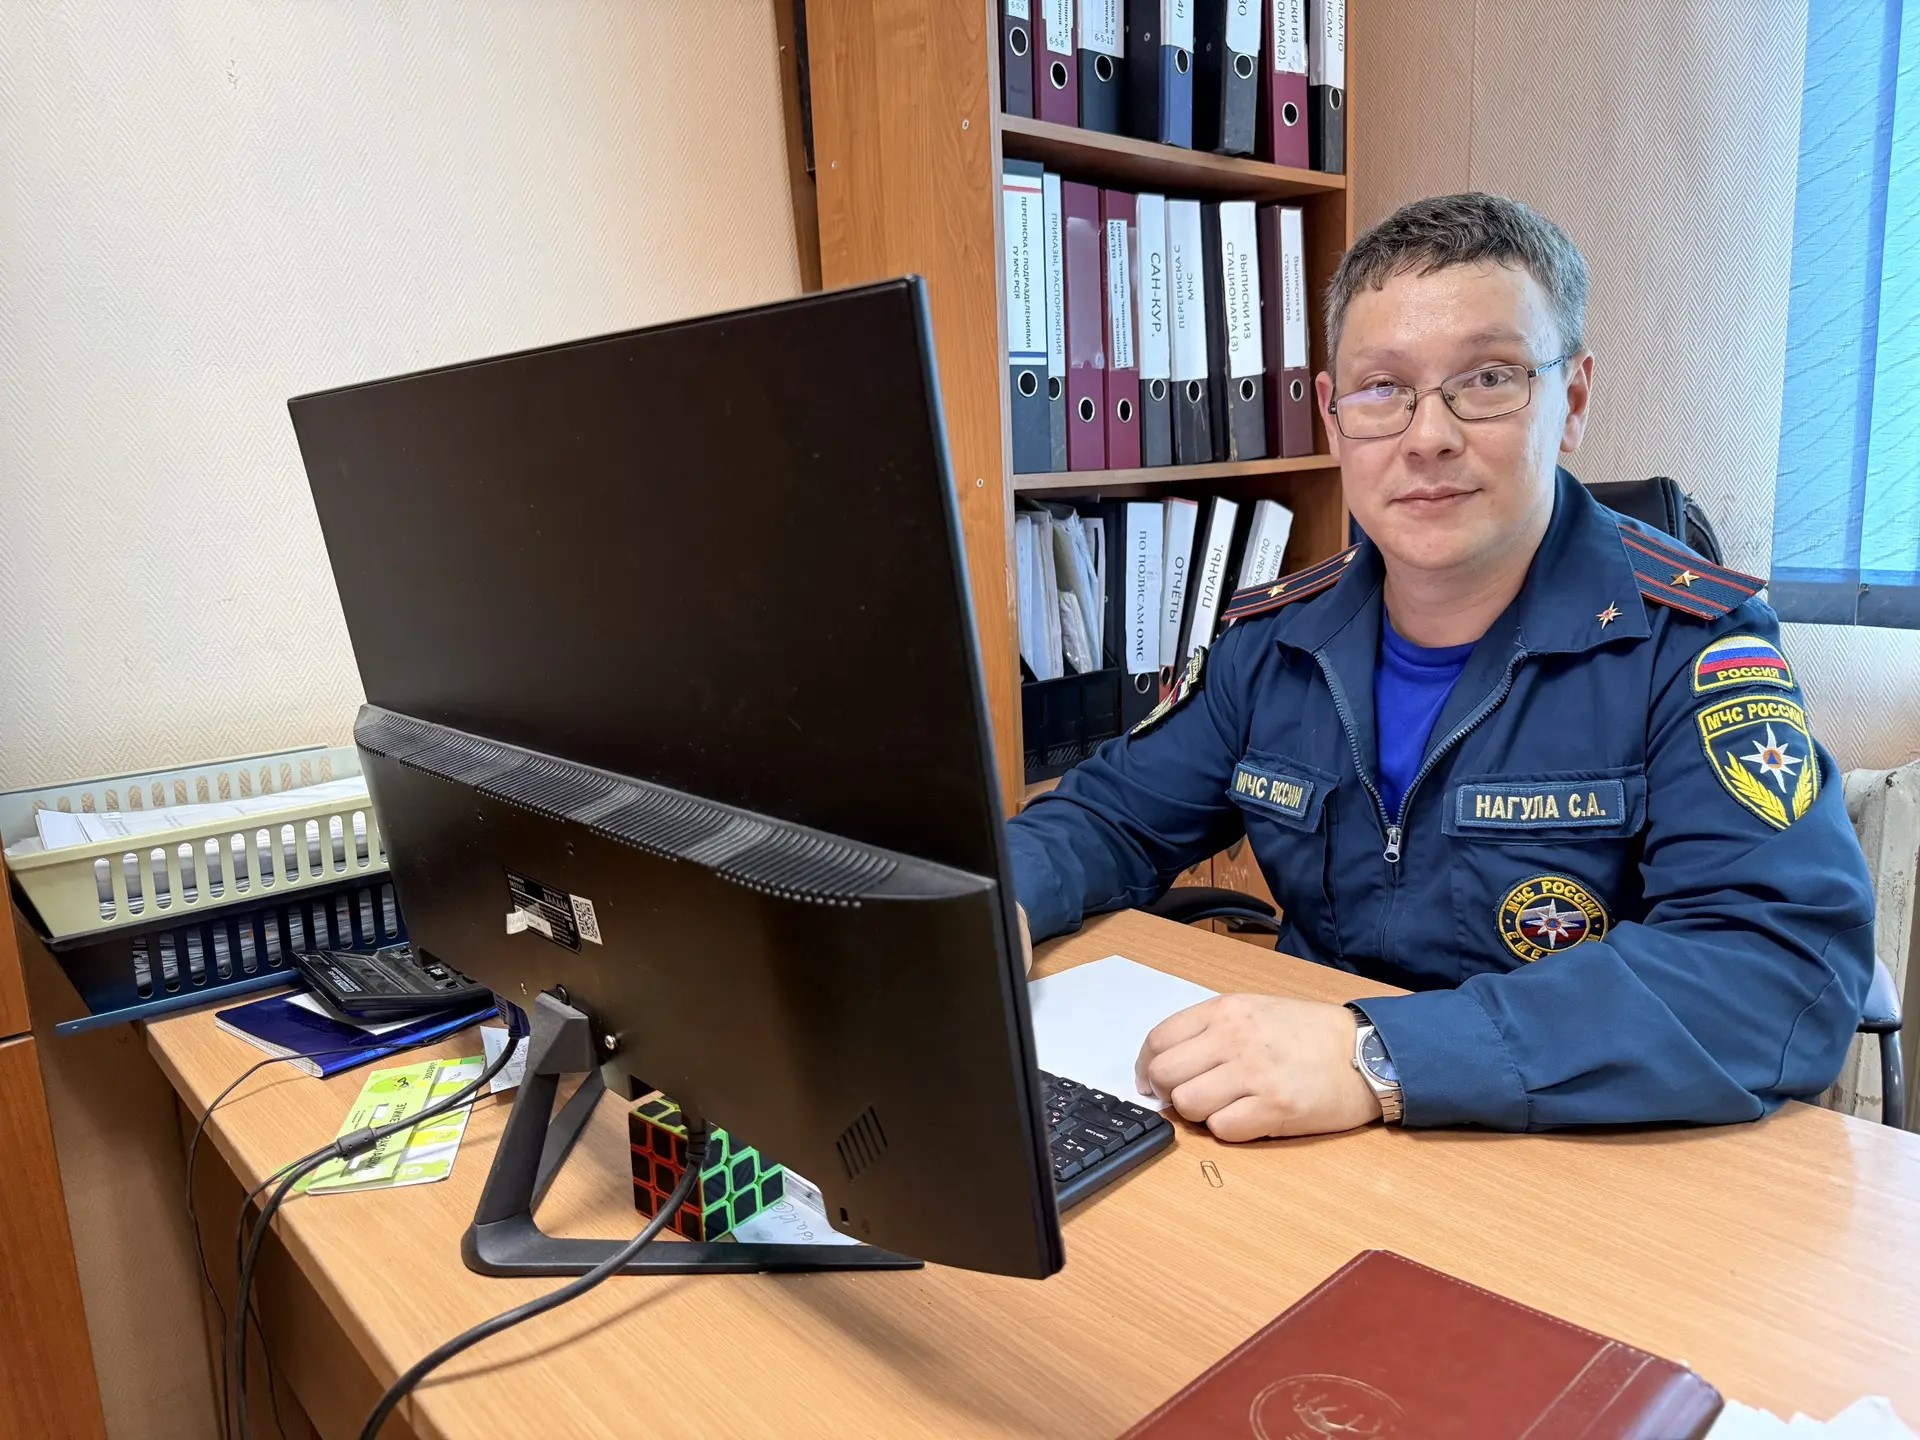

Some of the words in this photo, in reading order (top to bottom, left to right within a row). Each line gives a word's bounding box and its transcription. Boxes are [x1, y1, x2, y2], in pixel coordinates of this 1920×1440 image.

[1292, 29, 1299, 43] ИЗ
[1174, 245, 1180, 253] С
[1151, 252, 1162, 337] САН-КУР.
[1174, 257, 1184, 329] ПЕРЕПИСКА
[1186, 273, 1194, 300] МЧС
[1227, 242, 1238, 333] СТАЦИОНАРА
[1240, 254, 1250, 317] ВЫПИСКИ
[1023, 258, 1032, 348] ПОДРАЗДЕЛЕНИЯМИ
[1231, 336, 1239, 352] (3)
[1244, 323, 1251, 339] ИЗ
[1139, 530, 1147, 551] ПО
[1262, 538, 1271, 555] ПО
[1136, 554, 1146, 624] ПОЛИСАМ
[1169, 556, 1184, 624] ОТЧЁТЫ
[1202, 544, 1224, 609] ПЛАНЫ.
[1136, 628, 1144, 661] ОМС
[1716, 666, 1780, 681] РОССИЯ
[1705, 707, 1743, 731] МЧС
[1747, 702, 1802, 725] РОССИИ
[1236, 771, 1268, 799] МЧС
[1475, 794, 1560, 821] НАГУЛА
[1568, 792, 1606, 818] С.А.
[1506, 886, 1535, 914] МЧС
[1541, 881, 1602, 919] РОССИИ
